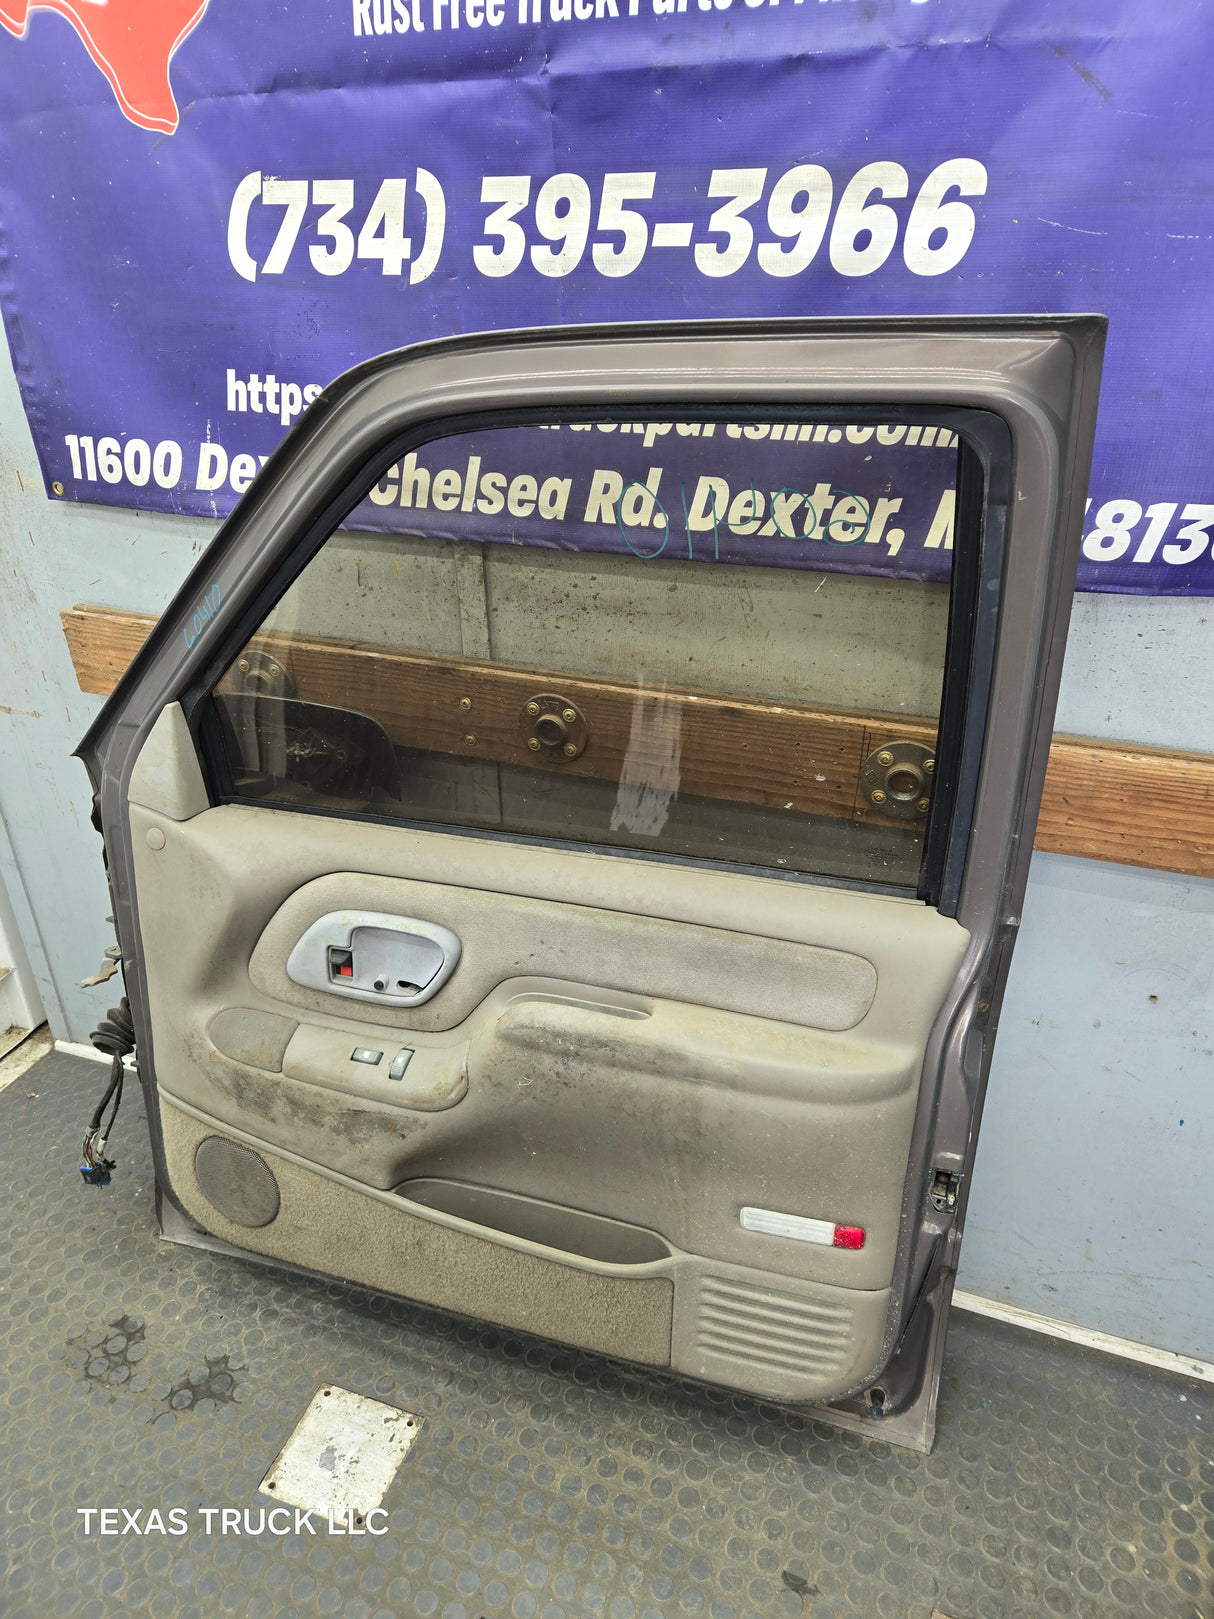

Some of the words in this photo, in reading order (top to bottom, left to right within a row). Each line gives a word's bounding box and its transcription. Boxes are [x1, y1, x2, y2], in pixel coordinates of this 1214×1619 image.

[227, 167, 446, 285] (734)
[473, 158, 988, 278] 395-3966
[65, 434, 183, 489] 11600
[368, 452, 573, 520] Chelsea
[584, 467, 669, 529] Rd.
[685, 476, 905, 556] Dexter,
[1081, 497, 1214, 565] 813
